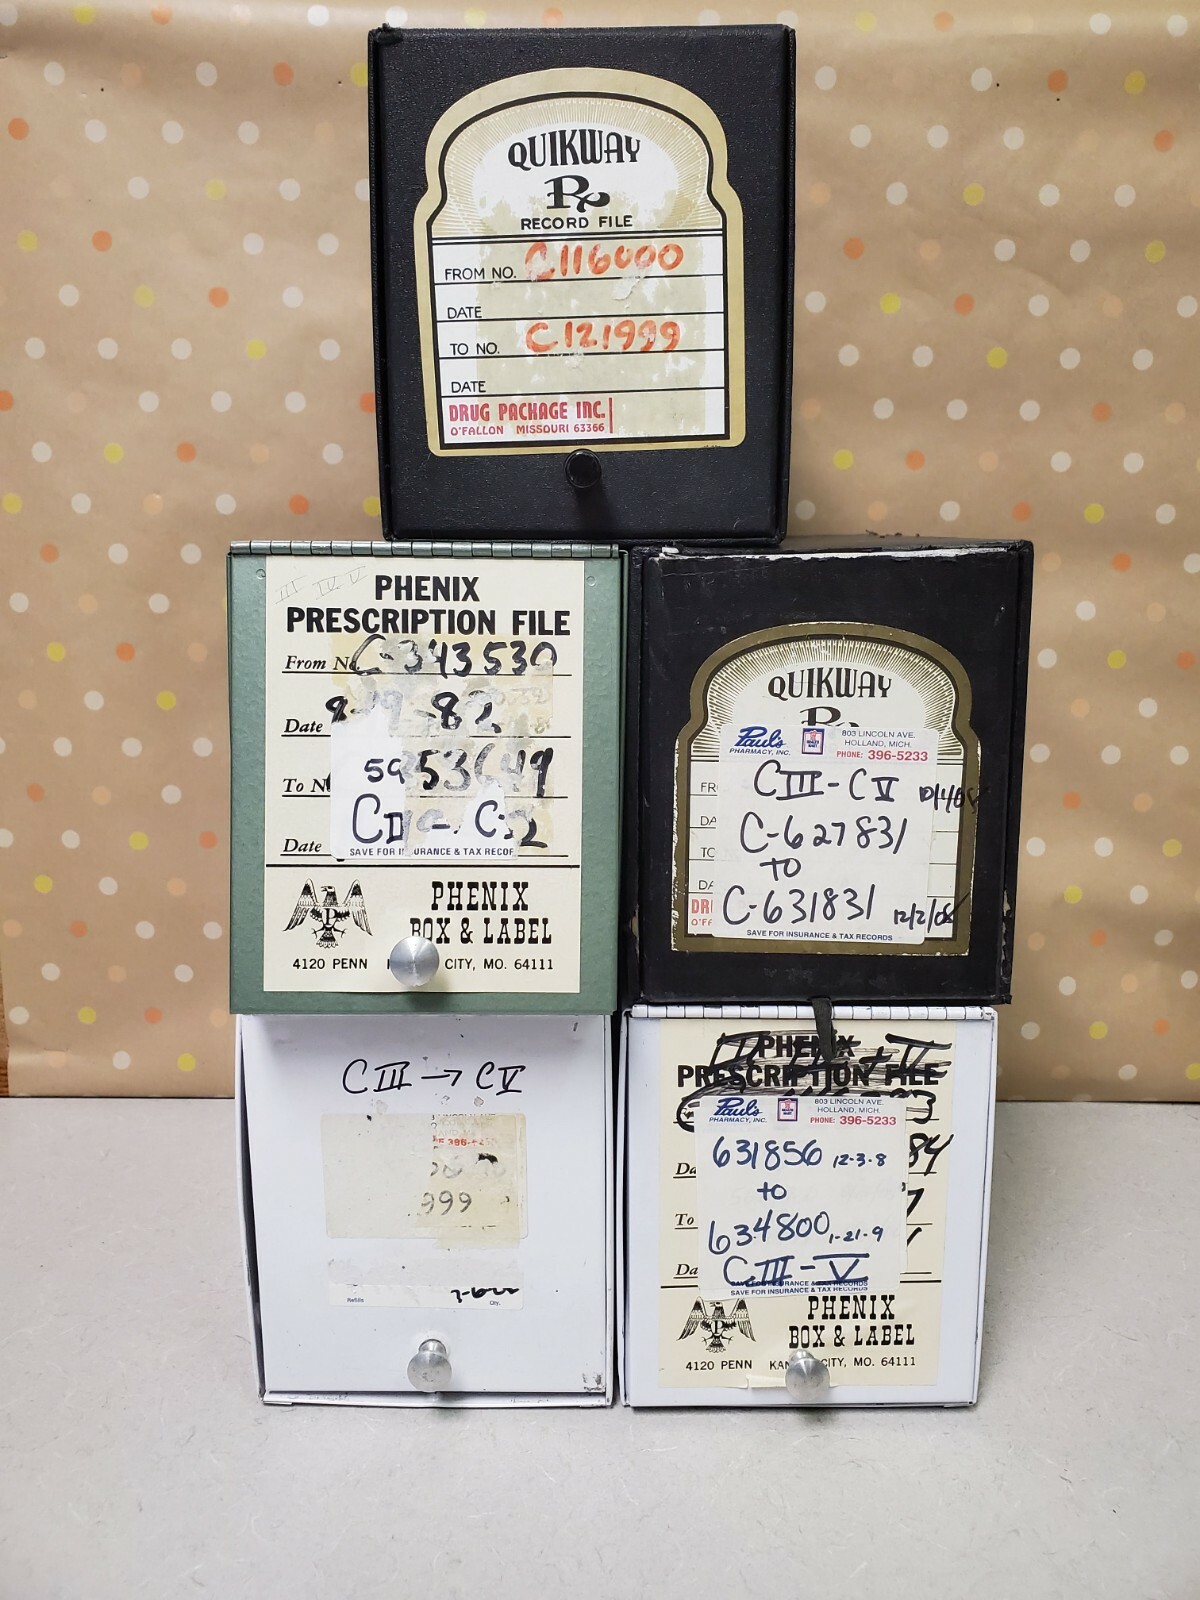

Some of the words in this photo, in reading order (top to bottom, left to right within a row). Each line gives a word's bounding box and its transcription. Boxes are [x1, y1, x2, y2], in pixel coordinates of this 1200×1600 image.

[507, 128, 641, 171] QUIKWAY
[521, 217, 589, 230] RECORD
[599, 215, 633, 228] FILE
[445, 268, 485, 281] FROM
[492, 267, 517, 280] NO.
[447, 306, 482, 319] DATE
[450, 343, 469, 355] TO
[476, 342, 500, 355] NO.
[451, 381, 486, 393] DATE
[449, 403, 490, 422] DRUG
[498, 401, 568, 421] PACKAGE
[576, 400, 606, 419] INC.
[450, 425, 504, 436] O'FALLON
[516, 423, 569, 435] MISSOURI
[573, 423, 605, 433] 63366
[375, 575, 480, 602] PHENIX
[286, 607, 496, 634] PRESCRIPTION
[512, 610, 571, 636] FILE
[285, 655, 326, 671] From
[768, 667, 892, 702] QUIKWAY
[284, 718, 323, 733] Date
[734, 726, 786, 748] Paul's
[858, 730, 895, 738] LINCOLN
[897, 731, 916, 739] AVE.
[844, 739, 886, 748] HOLLAND,
[889, 740, 912, 748] MICH.
[729, 748, 774, 756] PHARMACY,
[837, 751, 864, 759] PHONE:
[868, 750, 928, 762] 396-5233
[283, 778, 304, 793] To
[283, 838, 322, 853] Date
[349, 847, 375, 857] SAVE
[377, 847, 396, 856] FOR
[454, 847, 461, 856] &
[463, 847, 482, 856] TAX
[431, 881, 529, 911] PHENIX
[410, 917, 451, 945] BOX
[460, 917, 474, 944] &
[483, 917, 552, 944] LABEL
[747, 930, 765, 938] SAVE
[767, 930, 785, 938] FOR
[786, 931, 831, 939] INSURANCE
[832, 932, 838, 940] &
[855, 933, 893, 942] RECORDS
[292, 958, 325, 970] 4120
[332, 958, 368, 969] PENN
[445, 958, 476, 971] CITY,
[483, 958, 507, 970] MO.
[514, 958, 554, 970] 64111
[714, 1097, 763, 1117] Paul's
[817, 1106, 856, 1114] HOLLAND,
[859, 1106, 881, 1114] MICH.
[839, 1115, 897, 1126] 396-5233
[712, 1136, 823, 1171] 631856
[675, 1214, 694, 1226] To
[768, 1287, 809, 1295] INSURANCE
[808, 1295, 895, 1320] PHENIX
[789, 1326, 825, 1348] BOX
[833, 1325, 845, 1347] &
[854, 1324, 915, 1346] LABEL
[686, 1361, 715, 1370] 4120
[721, 1360, 752, 1370] PENN
[853, 1357, 875, 1367] MO.
[881, 1356, 916, 1367] 64111
